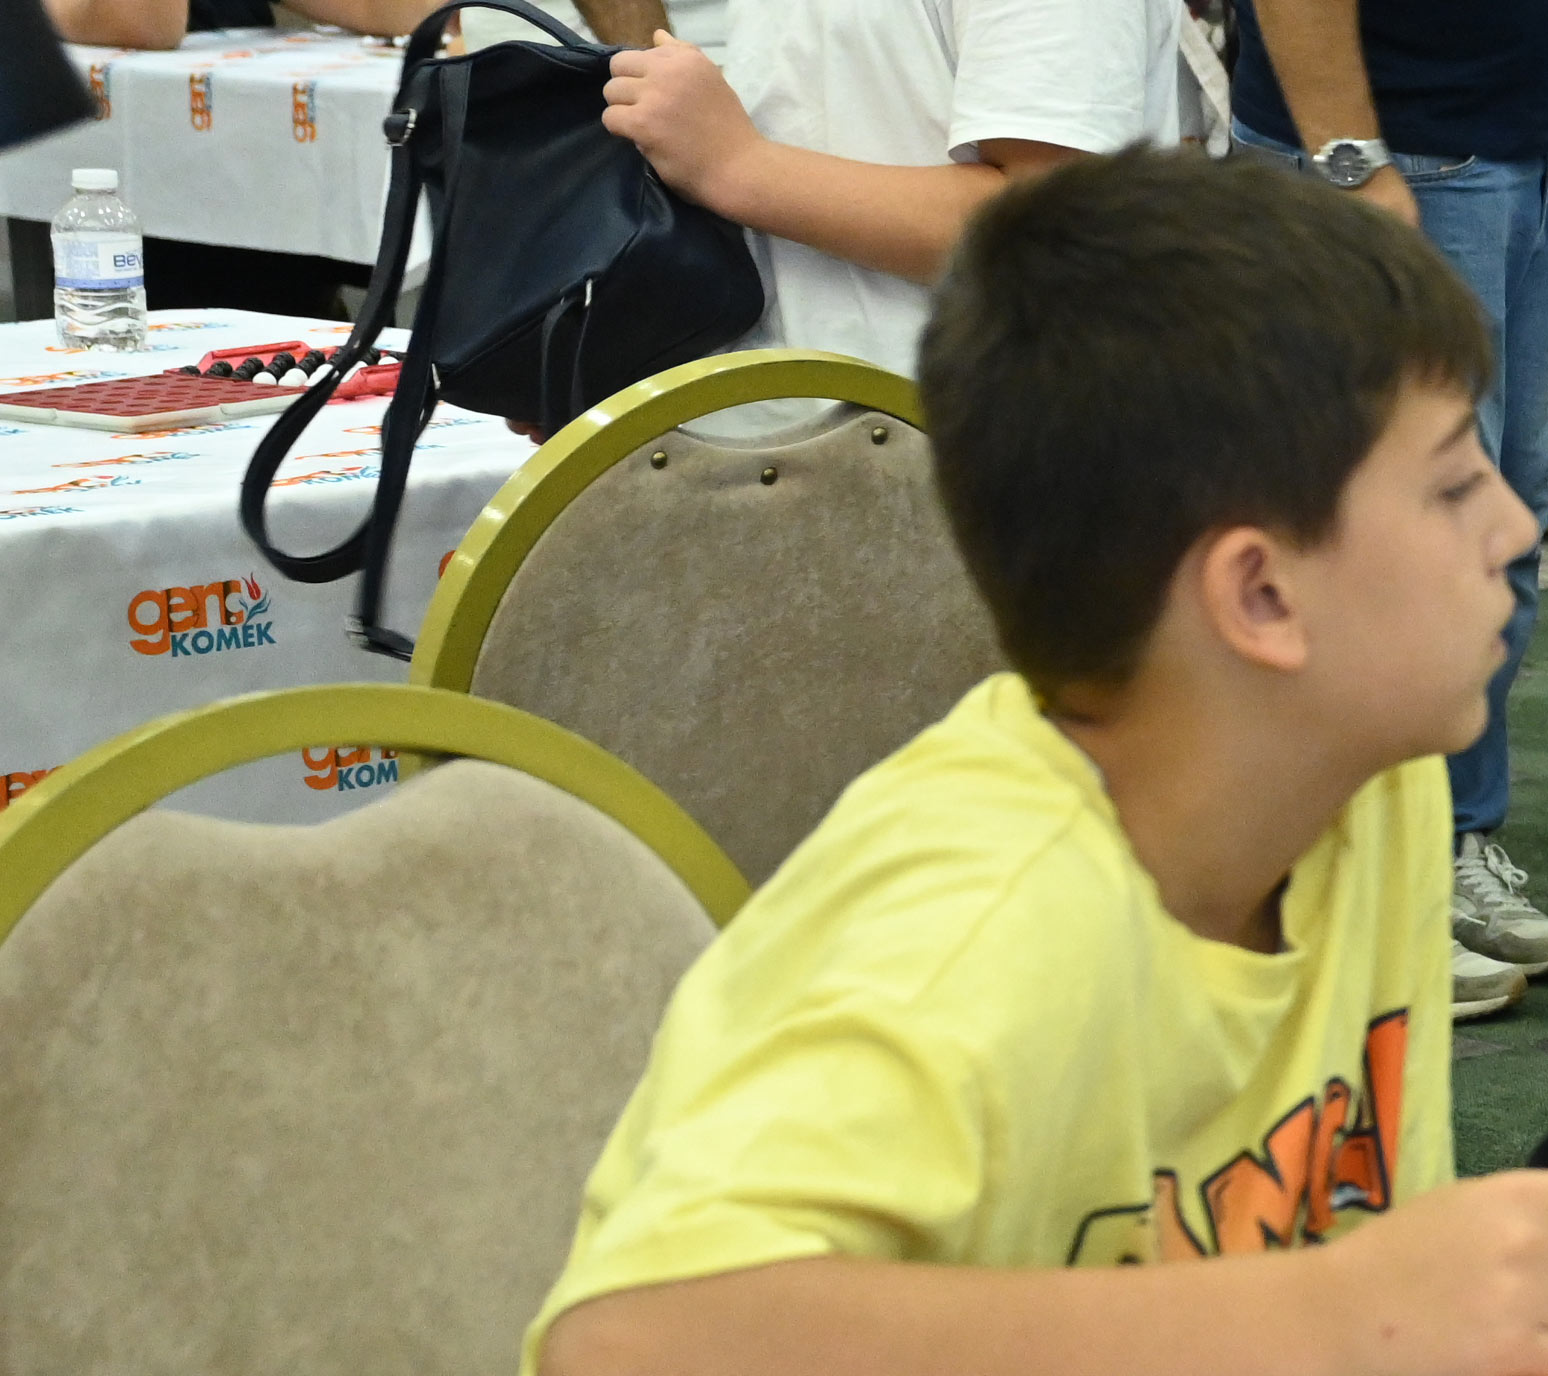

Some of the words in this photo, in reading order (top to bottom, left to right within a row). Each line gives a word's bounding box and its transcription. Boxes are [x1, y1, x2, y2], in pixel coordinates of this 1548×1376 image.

[128, 579, 245, 655] genç
[171, 621, 277, 657] KOMEK
[337, 760, 399, 792] KOM
